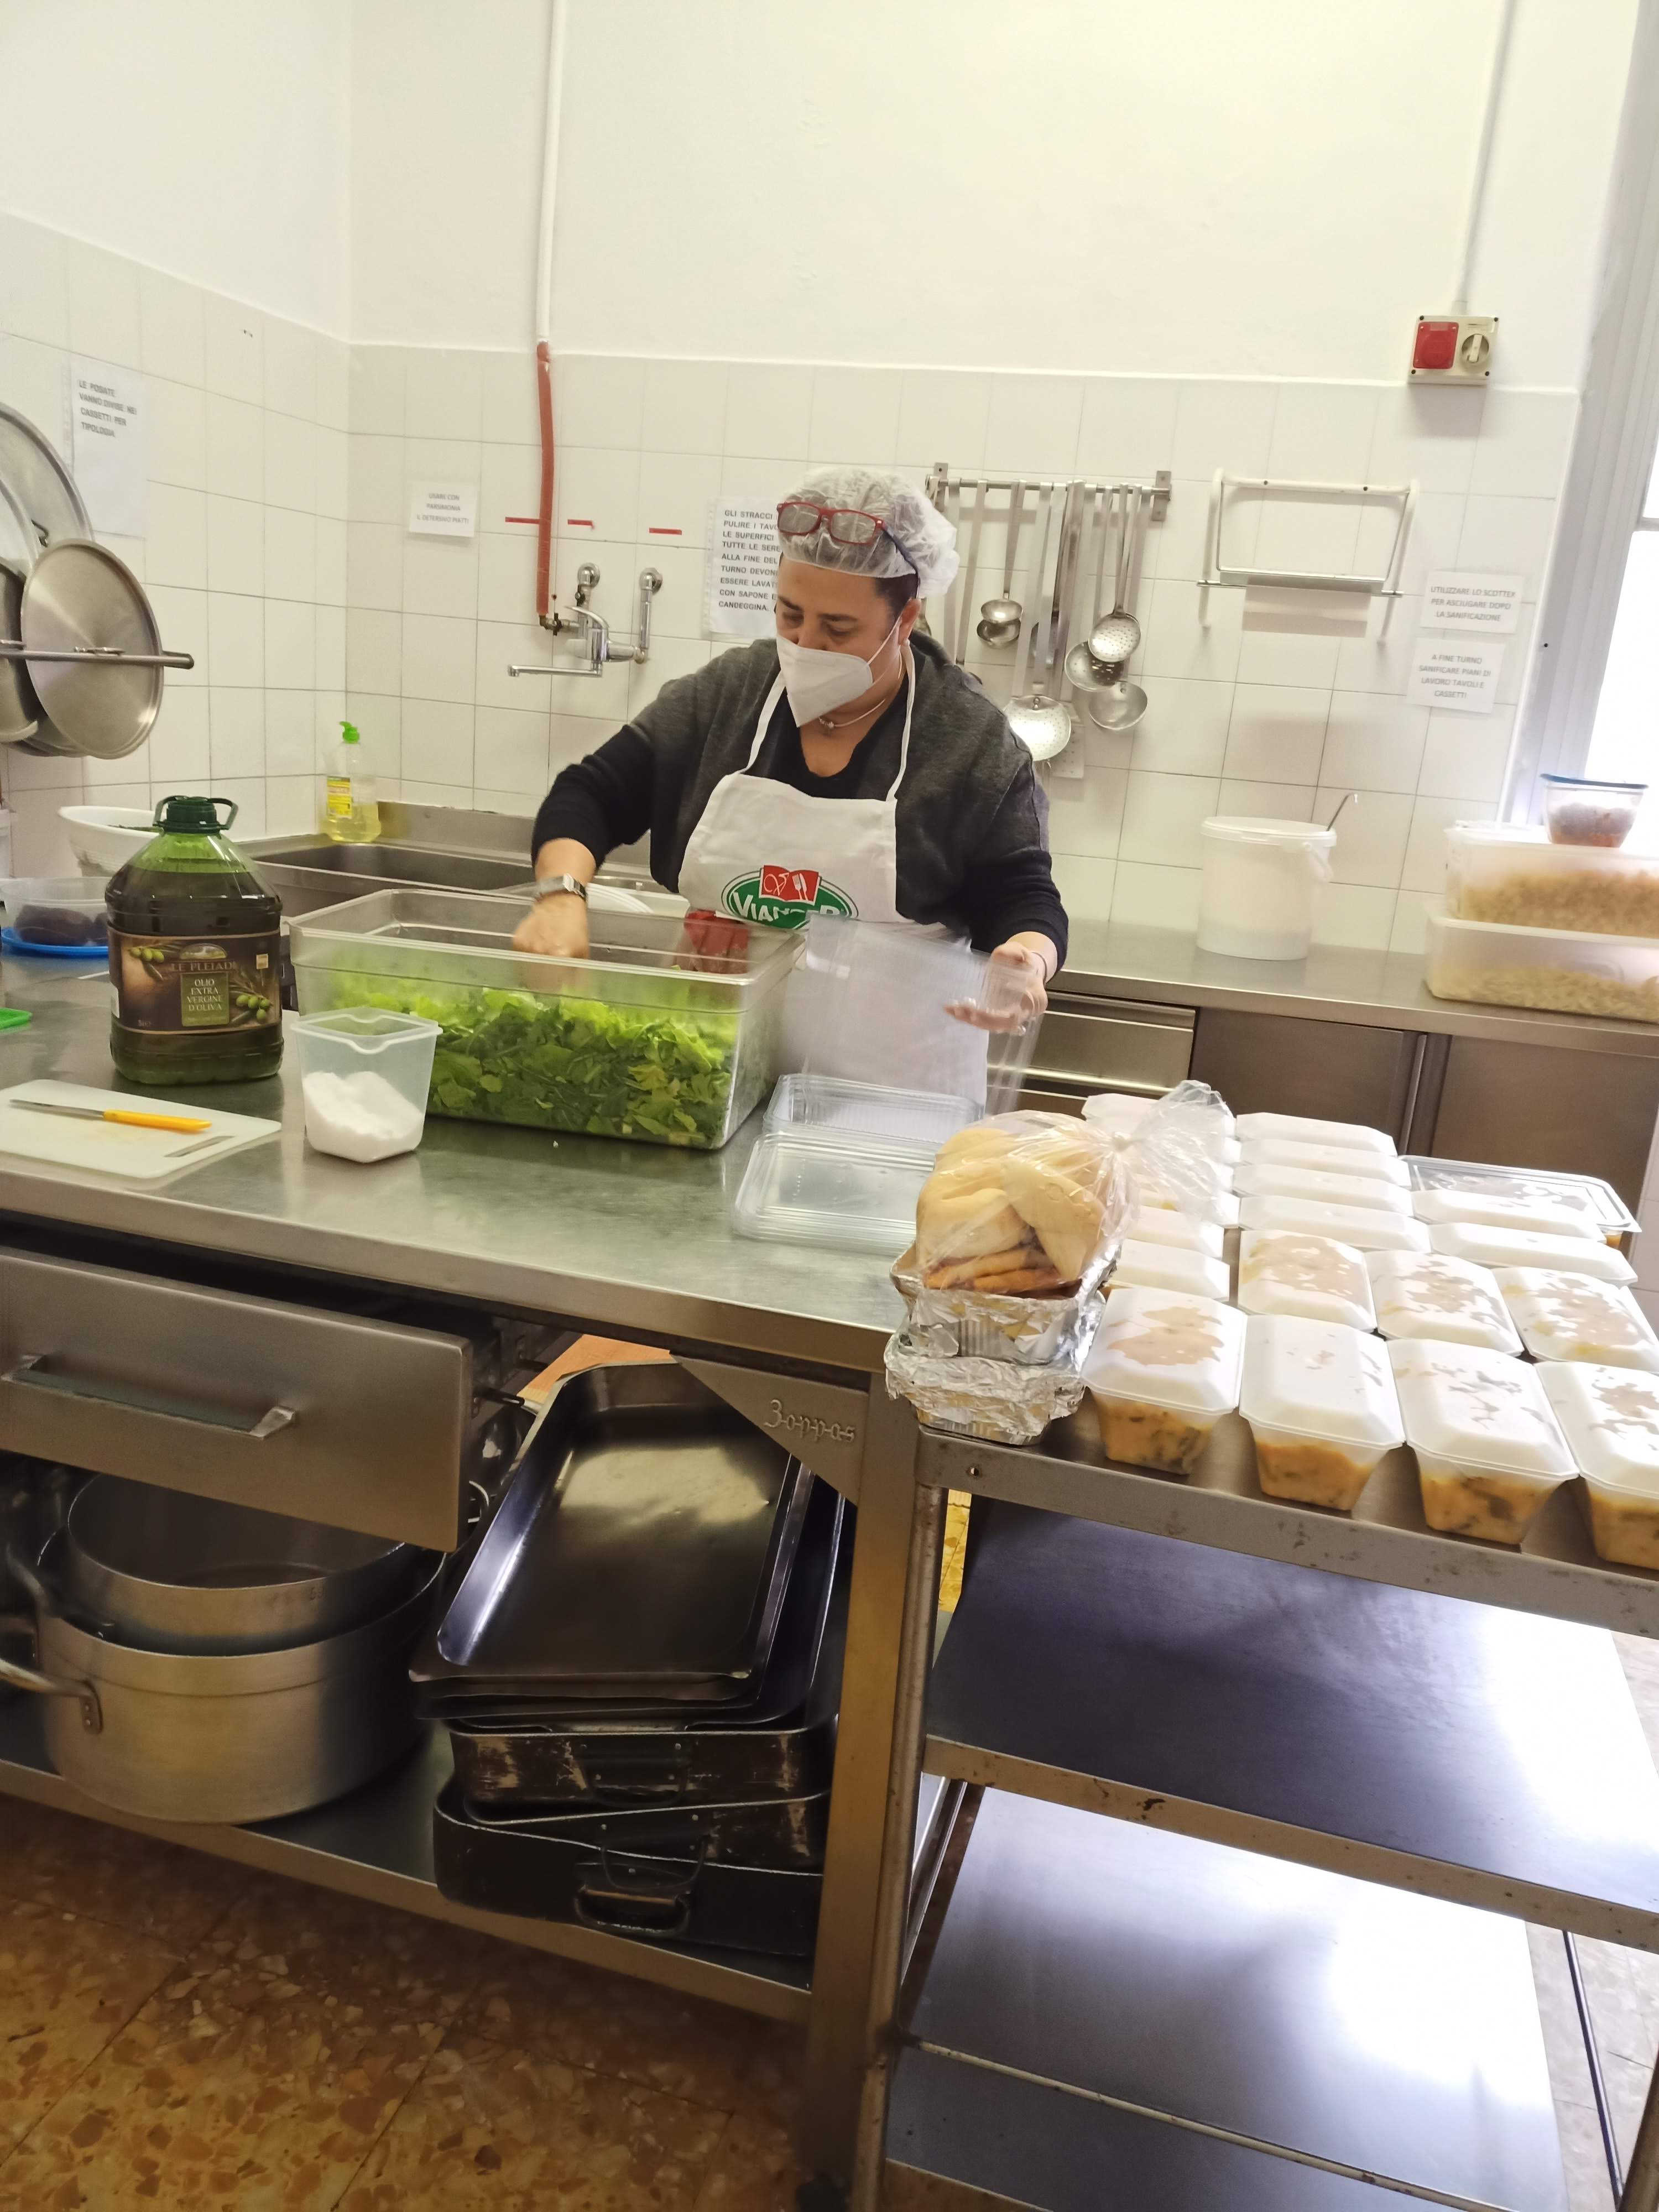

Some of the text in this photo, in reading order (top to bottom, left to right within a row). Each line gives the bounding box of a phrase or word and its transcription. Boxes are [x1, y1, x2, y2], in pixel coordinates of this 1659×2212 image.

[79, 379, 115, 398] LE POSATE
[79, 392, 102, 405] VANNO
[127, 406, 137, 415] NEI
[81, 407, 126, 426] CASSETTI PER
[740, 511, 773, 520] STRACCI
[724, 520, 750, 529] PULIRE
[735, 532, 774, 541] SUPERFICI
[721, 565, 746, 573] TURNO
[720, 577, 749, 586] ESSERE
[739, 591, 769, 599] SAPONE
[1431, 586, 1470, 595] UTILIZZARE
[1447, 599, 1486, 608] ASCIUGARE
[1447, 612, 1501, 622] SANIFICAZIONE
[1457, 656, 1483, 664] TURNO
[1419, 665, 1460, 675] SANIFICARE
[1453, 680, 1478, 688] TAVOLI
[171, 963, 186, 972] LE
[194, 978, 215, 987] OLIO
[187, 995, 223, 1003] VERGINE
